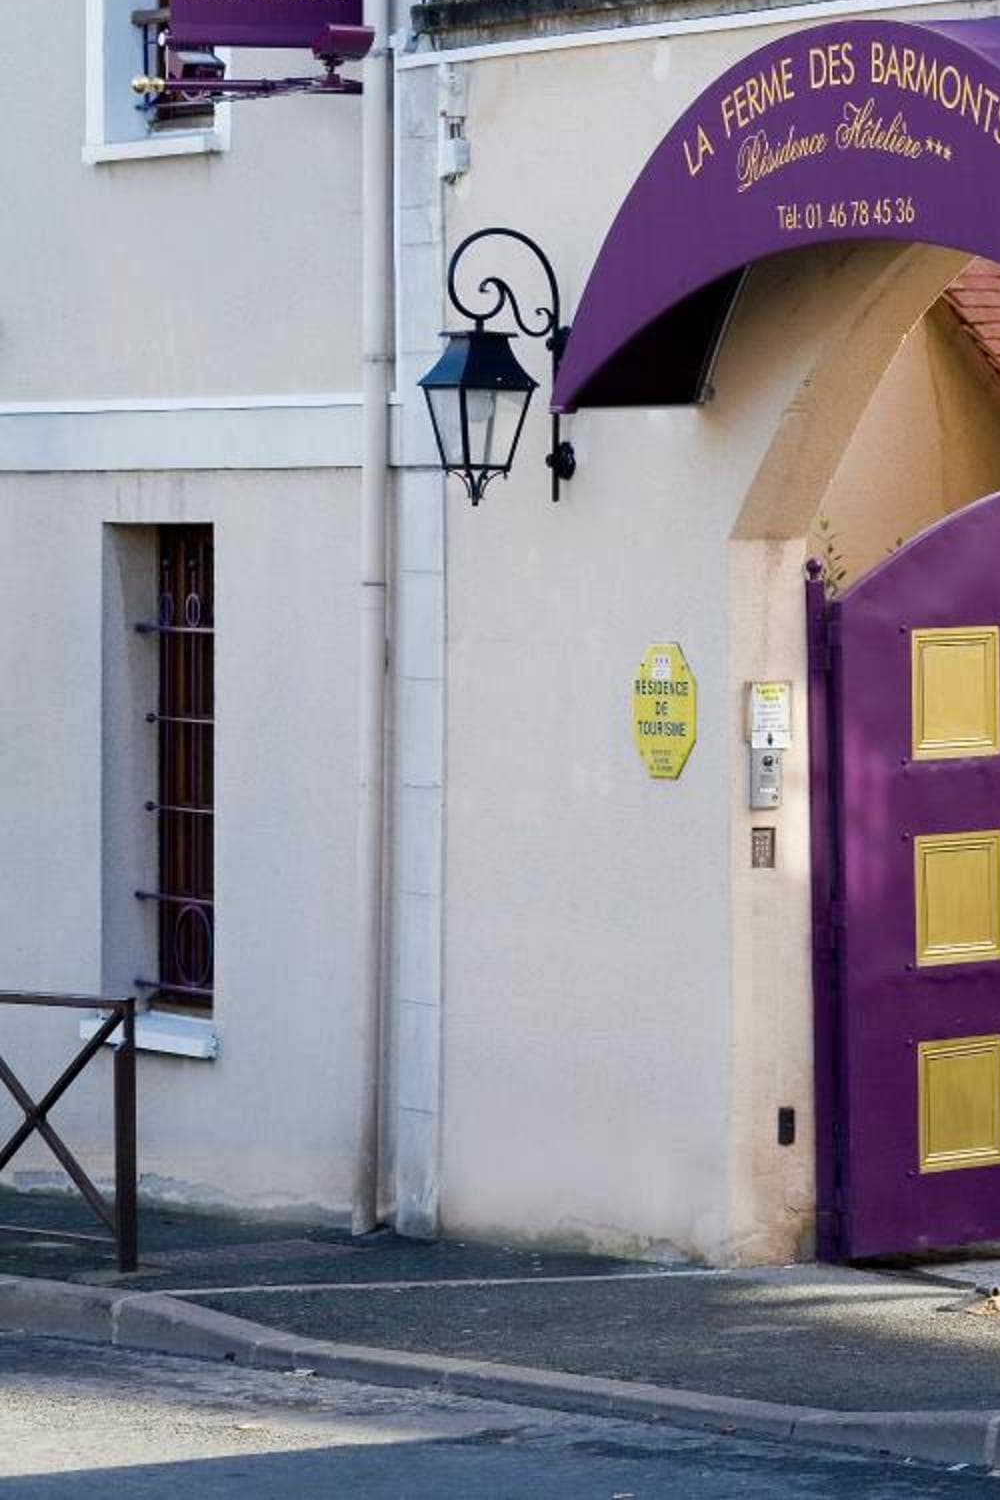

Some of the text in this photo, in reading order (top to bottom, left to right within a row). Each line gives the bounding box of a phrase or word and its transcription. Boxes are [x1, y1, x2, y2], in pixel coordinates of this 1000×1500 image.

[683, 124, 715, 176] LA
[720, 57, 796, 138] FERME
[809, 43, 856, 89] DES
[777, 198, 915, 230] Tél: 01 46 78 45 36
[655, 701, 669, 715] DE
